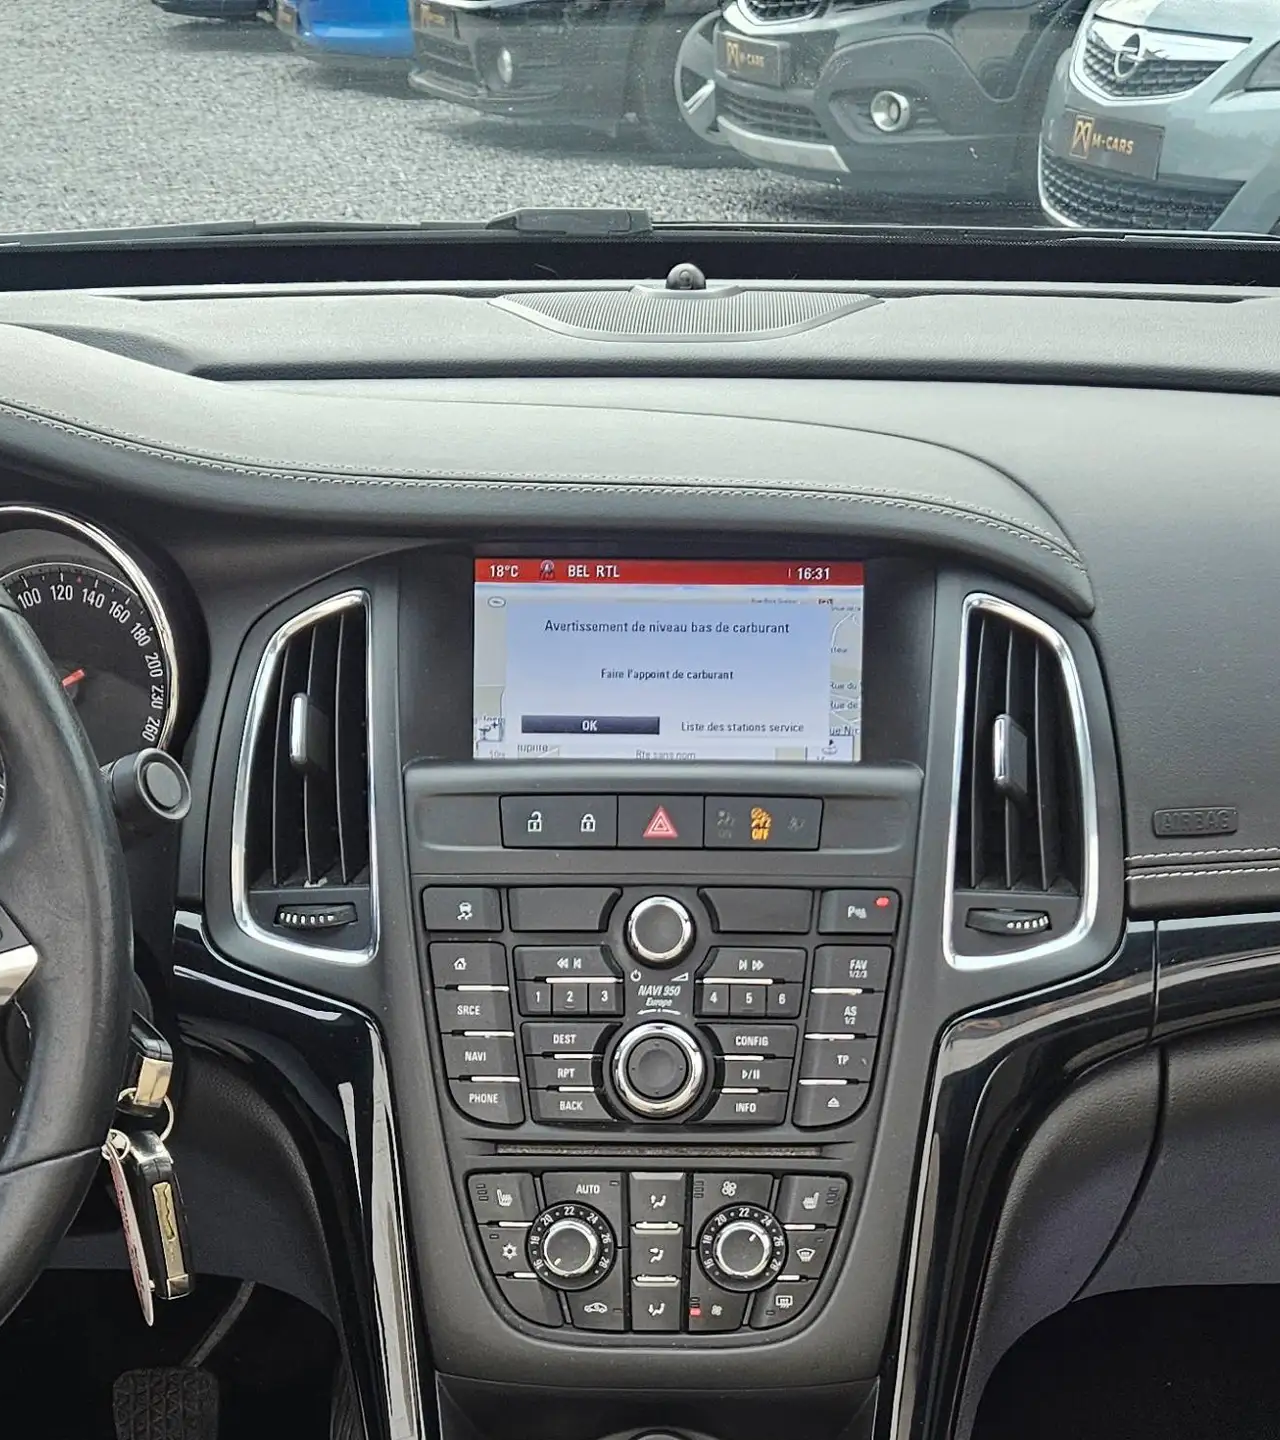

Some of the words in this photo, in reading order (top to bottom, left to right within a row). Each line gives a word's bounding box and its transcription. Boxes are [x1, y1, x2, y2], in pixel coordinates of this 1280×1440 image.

[1091, 132, 1134, 155] M-CARS
[489, 565, 519, 578] 18°C
[568, 565, 589, 578] BEL
[596, 565, 620, 578] RTL
[797, 567, 831, 581] 16:31
[18, 588, 42, 608] 100
[49, 585, 73, 601] 120
[81, 588, 105, 609] 140
[108, 600, 131, 624] 160
[544, 619, 629, 634] Avertissement
[632, 620, 646, 633] de
[649, 620, 687, 634] niveau
[691, 621, 712, 634] bas
[715, 621, 730, 634] de
[732, 621, 790, 635] carburant
[130, 622, 152, 647] 180
[144, 653, 163, 678] 200
[600, 668, 625, 680] Faire
[627, 668, 670, 682] l'appoint
[672, 669, 684, 680] de
[686, 668, 734, 681] carburant
[150, 685, 165, 710] 230
[142, 716, 161, 742] 260
[581, 720, 598, 732] OK
[680, 721, 703, 733] Liste
[706, 721, 725, 733] des
[728, 722, 766, 733] stations
[768, 722, 805, 733] service
[849, 959, 868, 970] FAV
[849, 970, 868, 979] 1/2/3
[566, 991, 574, 1002] 2
[601, 990, 608, 1002] 3
[637, 985, 662, 996] NAVI
[663, 985, 682, 996] 950
[535, 991, 541, 1003] 1
[645, 997, 673, 1007] Europe
[710, 991, 718, 1003] 4
[745, 992, 753, 1004] 5
[778, 993, 786, 1004] 6
[457, 1004, 480, 1016] SRCE
[843, 1005, 857, 1016] AS
[845, 1016, 856, 1025] 1/2
[553, 1033, 577, 1045] DEST
[735, 1035, 769, 1047] CONFIG
[464, 1050, 487, 1062] NAVI
[837, 1054, 849, 1065] TP
[557, 1067, 575, 1079] RPT
[468, 1092, 498, 1104] PHONE
[559, 1100, 583, 1112] BACK
[735, 1101, 757, 1114] INFO
[575, 1183, 600, 1195] AUTO
[564, 1206, 575, 1216] 22
[738, 1207, 750, 1217] 22
[541, 1213, 554, 1226] 20
[587, 1212, 599, 1224] 24
[714, 1213, 727, 1226] 20
[761, 1214, 773, 1226] 24
[531, 1234, 540, 1245] 18
[601, 1232, 610, 1245] 26
[703, 1234, 712, 1245] 18
[773, 1234, 783, 1247] 26
